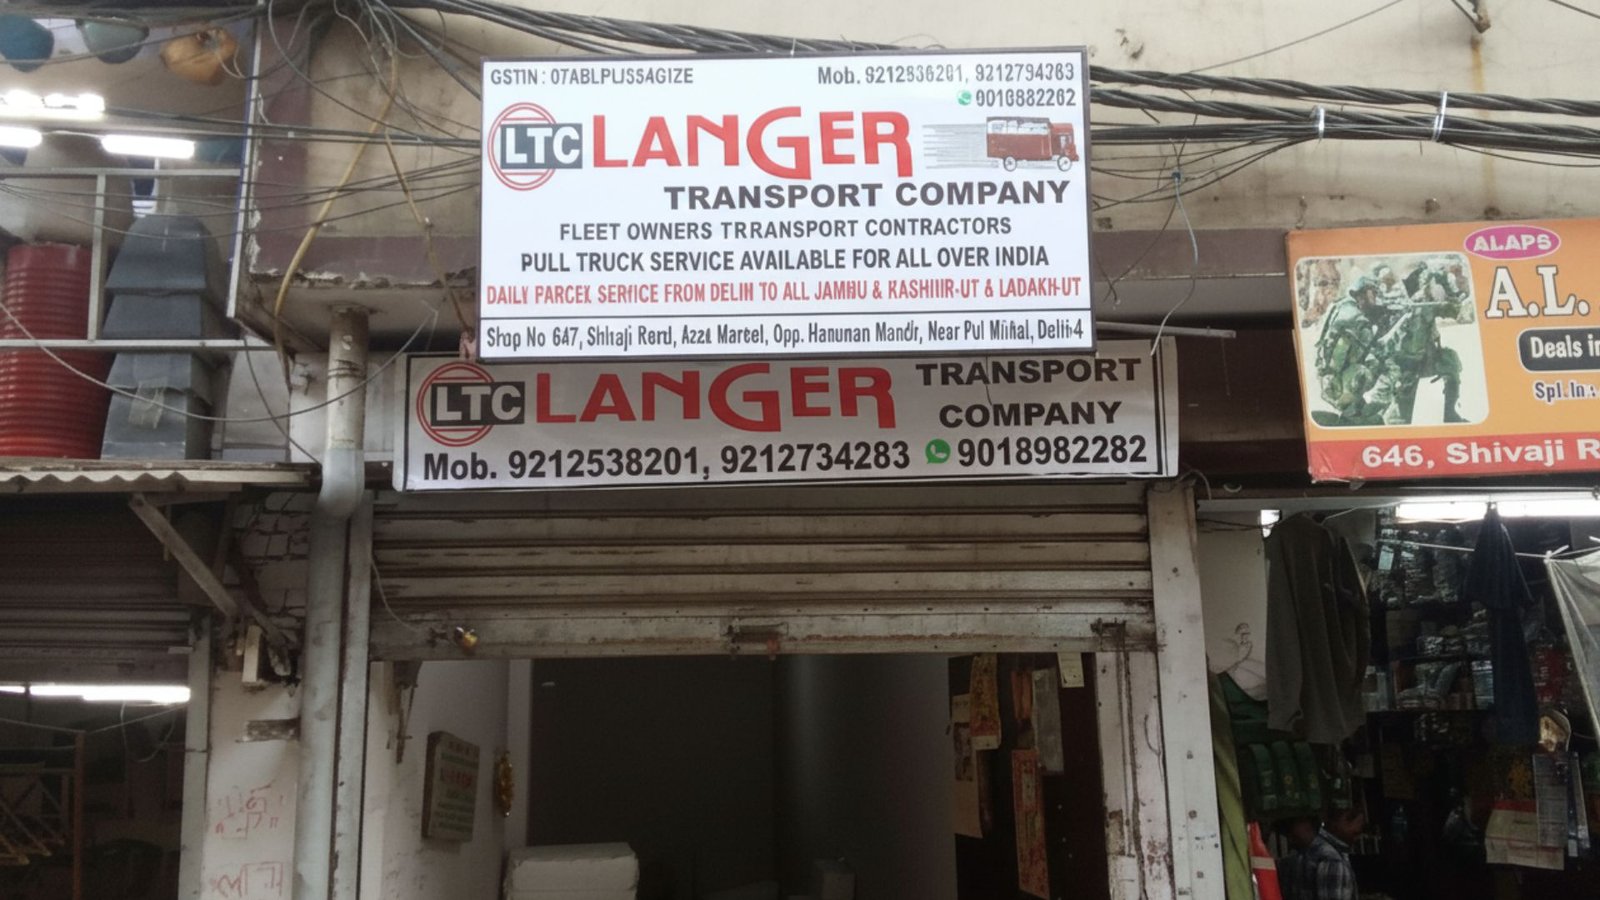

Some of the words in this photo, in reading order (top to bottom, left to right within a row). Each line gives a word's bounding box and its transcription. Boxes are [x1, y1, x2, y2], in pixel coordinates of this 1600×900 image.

[491, 68, 539, 85] GSTIN
[817, 66, 861, 85] Mob.
[505, 126, 581, 165] LTC
[593, 106, 913, 180] LANGER
[664, 183, 883, 210] TRANSPORT
[895, 180, 1070, 206] COMPANY
[560, 222, 621, 240] FLEET
[627, 221, 713, 240] OWNERS
[721, 219, 859, 239] TRRANSPORT
[865, 216, 1012, 237] CONTRACTORS
[1473, 233, 1552, 252] ALAPS
[521, 252, 571, 272] PULL
[576, 252, 645, 272] TRUCK
[650, 250, 735, 271] SERVICE
[740, 248, 846, 270] AVAILABLE
[853, 248, 891, 269] FOR
[896, 247, 932, 268] ALL
[937, 246, 990, 267] OVER
[996, 245, 1050, 266] INDIA
[664, 282, 706, 303] FROM
[759, 281, 778, 301] TO
[783, 281, 810, 301] ALL
[872, 280, 883, 300] &
[487, 326, 521, 351] Shop
[526, 325, 546, 347] No
[774, 322, 805, 347] Opp.
[928, 321, 960, 342] Near
[964, 319, 985, 341] Pul
[1530, 334, 1582, 359] Deals
[916, 358, 1141, 386] TRANSPORT
[436, 385, 522, 421] LTC
[536, 362, 896, 432] LANGER
[939, 401, 1121, 428] COMPANY
[424, 452, 498, 481] Mob.
[509, 446, 710, 480] 9212538201,
[721, 440, 910, 473] 9212734283
[958, 435, 1147, 467] 9018982282
[1362, 445, 1435, 469] 646,
[1446, 439, 1564, 467] Shivaji
